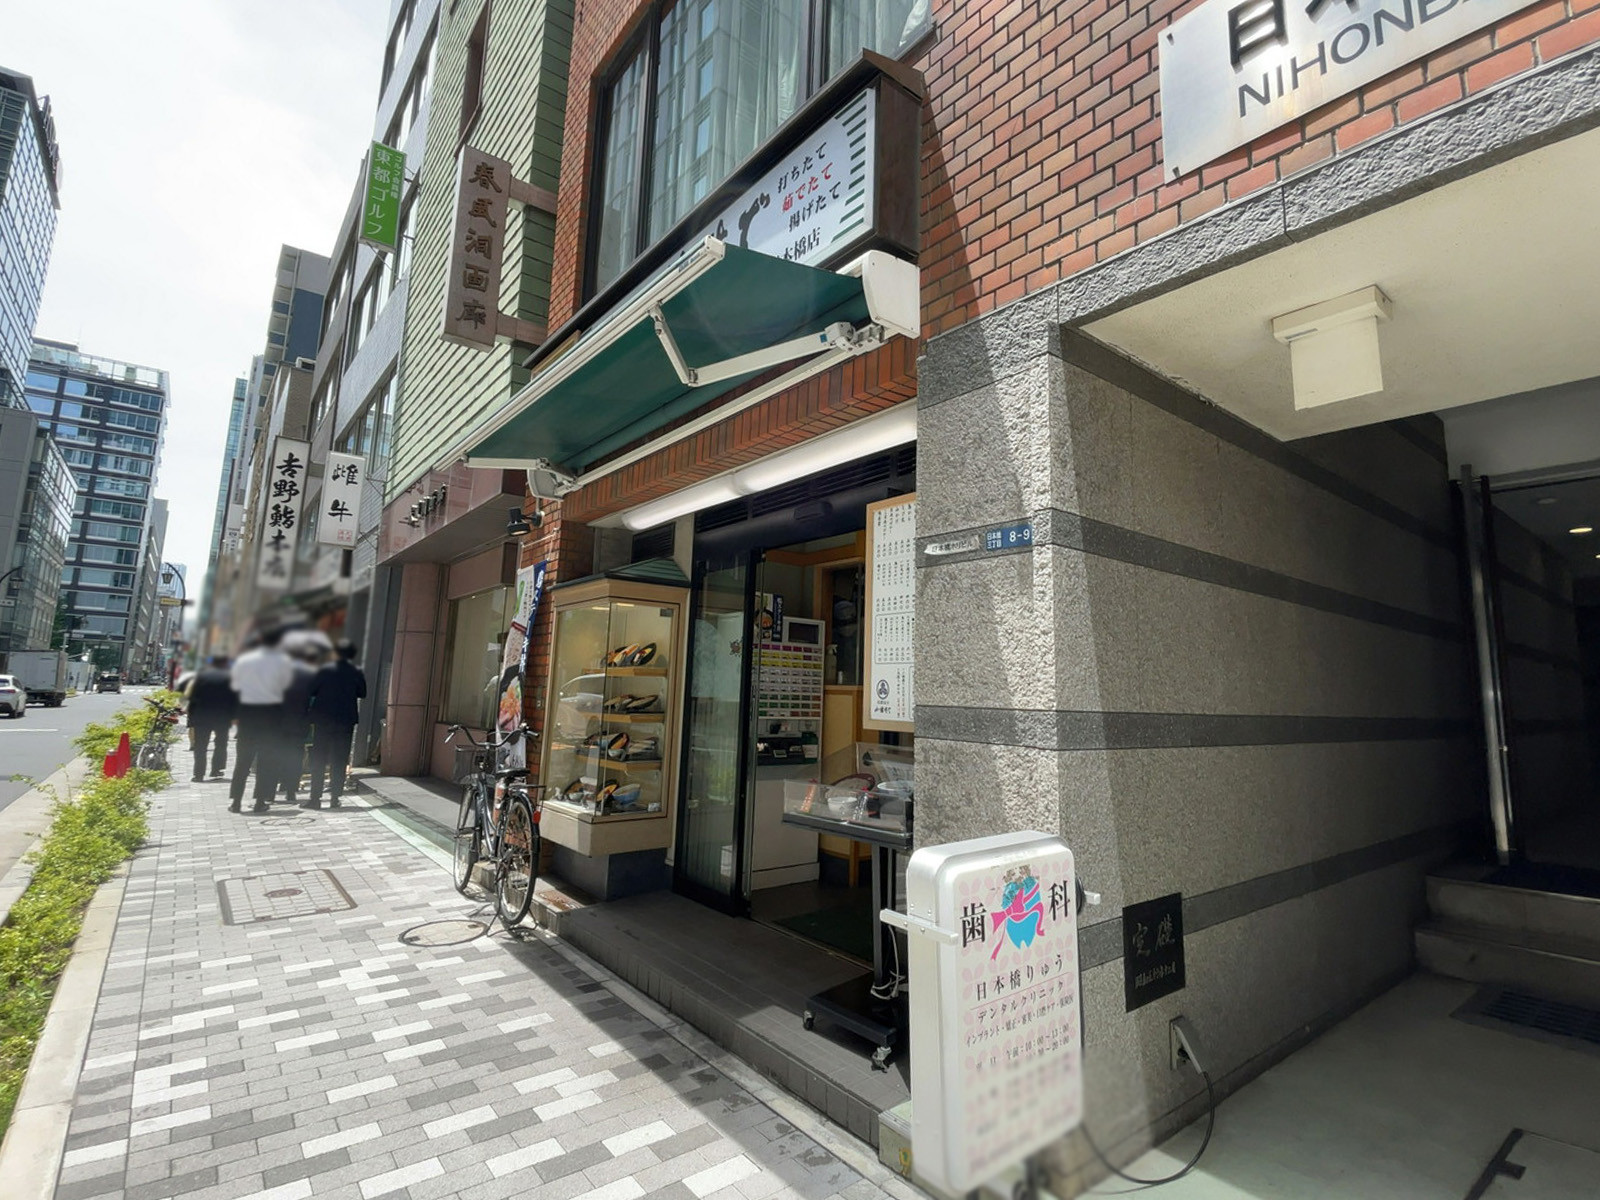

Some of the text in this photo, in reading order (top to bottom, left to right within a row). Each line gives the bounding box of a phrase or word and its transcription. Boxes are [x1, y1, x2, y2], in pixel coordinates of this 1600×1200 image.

[1228, 0, 1362, 72] 日
[1238, 0, 1472, 118] NIHONB
[368, 147, 393, 235] 東都ゴルフ
[777, 141, 827, 194] 打ちたて
[781, 162, 834, 213] 茹でたて
[788, 181, 842, 233] 揚げたて
[776, 227, 821, 261] 本橋店
[1009, 529, 1030, 543] 8-9
[959, 880, 1071, 948] 歯 科
[975, 954, 1064, 1001] 日本橋りゅう
[977, 980, 1065, 1024] デンタルクリニック
